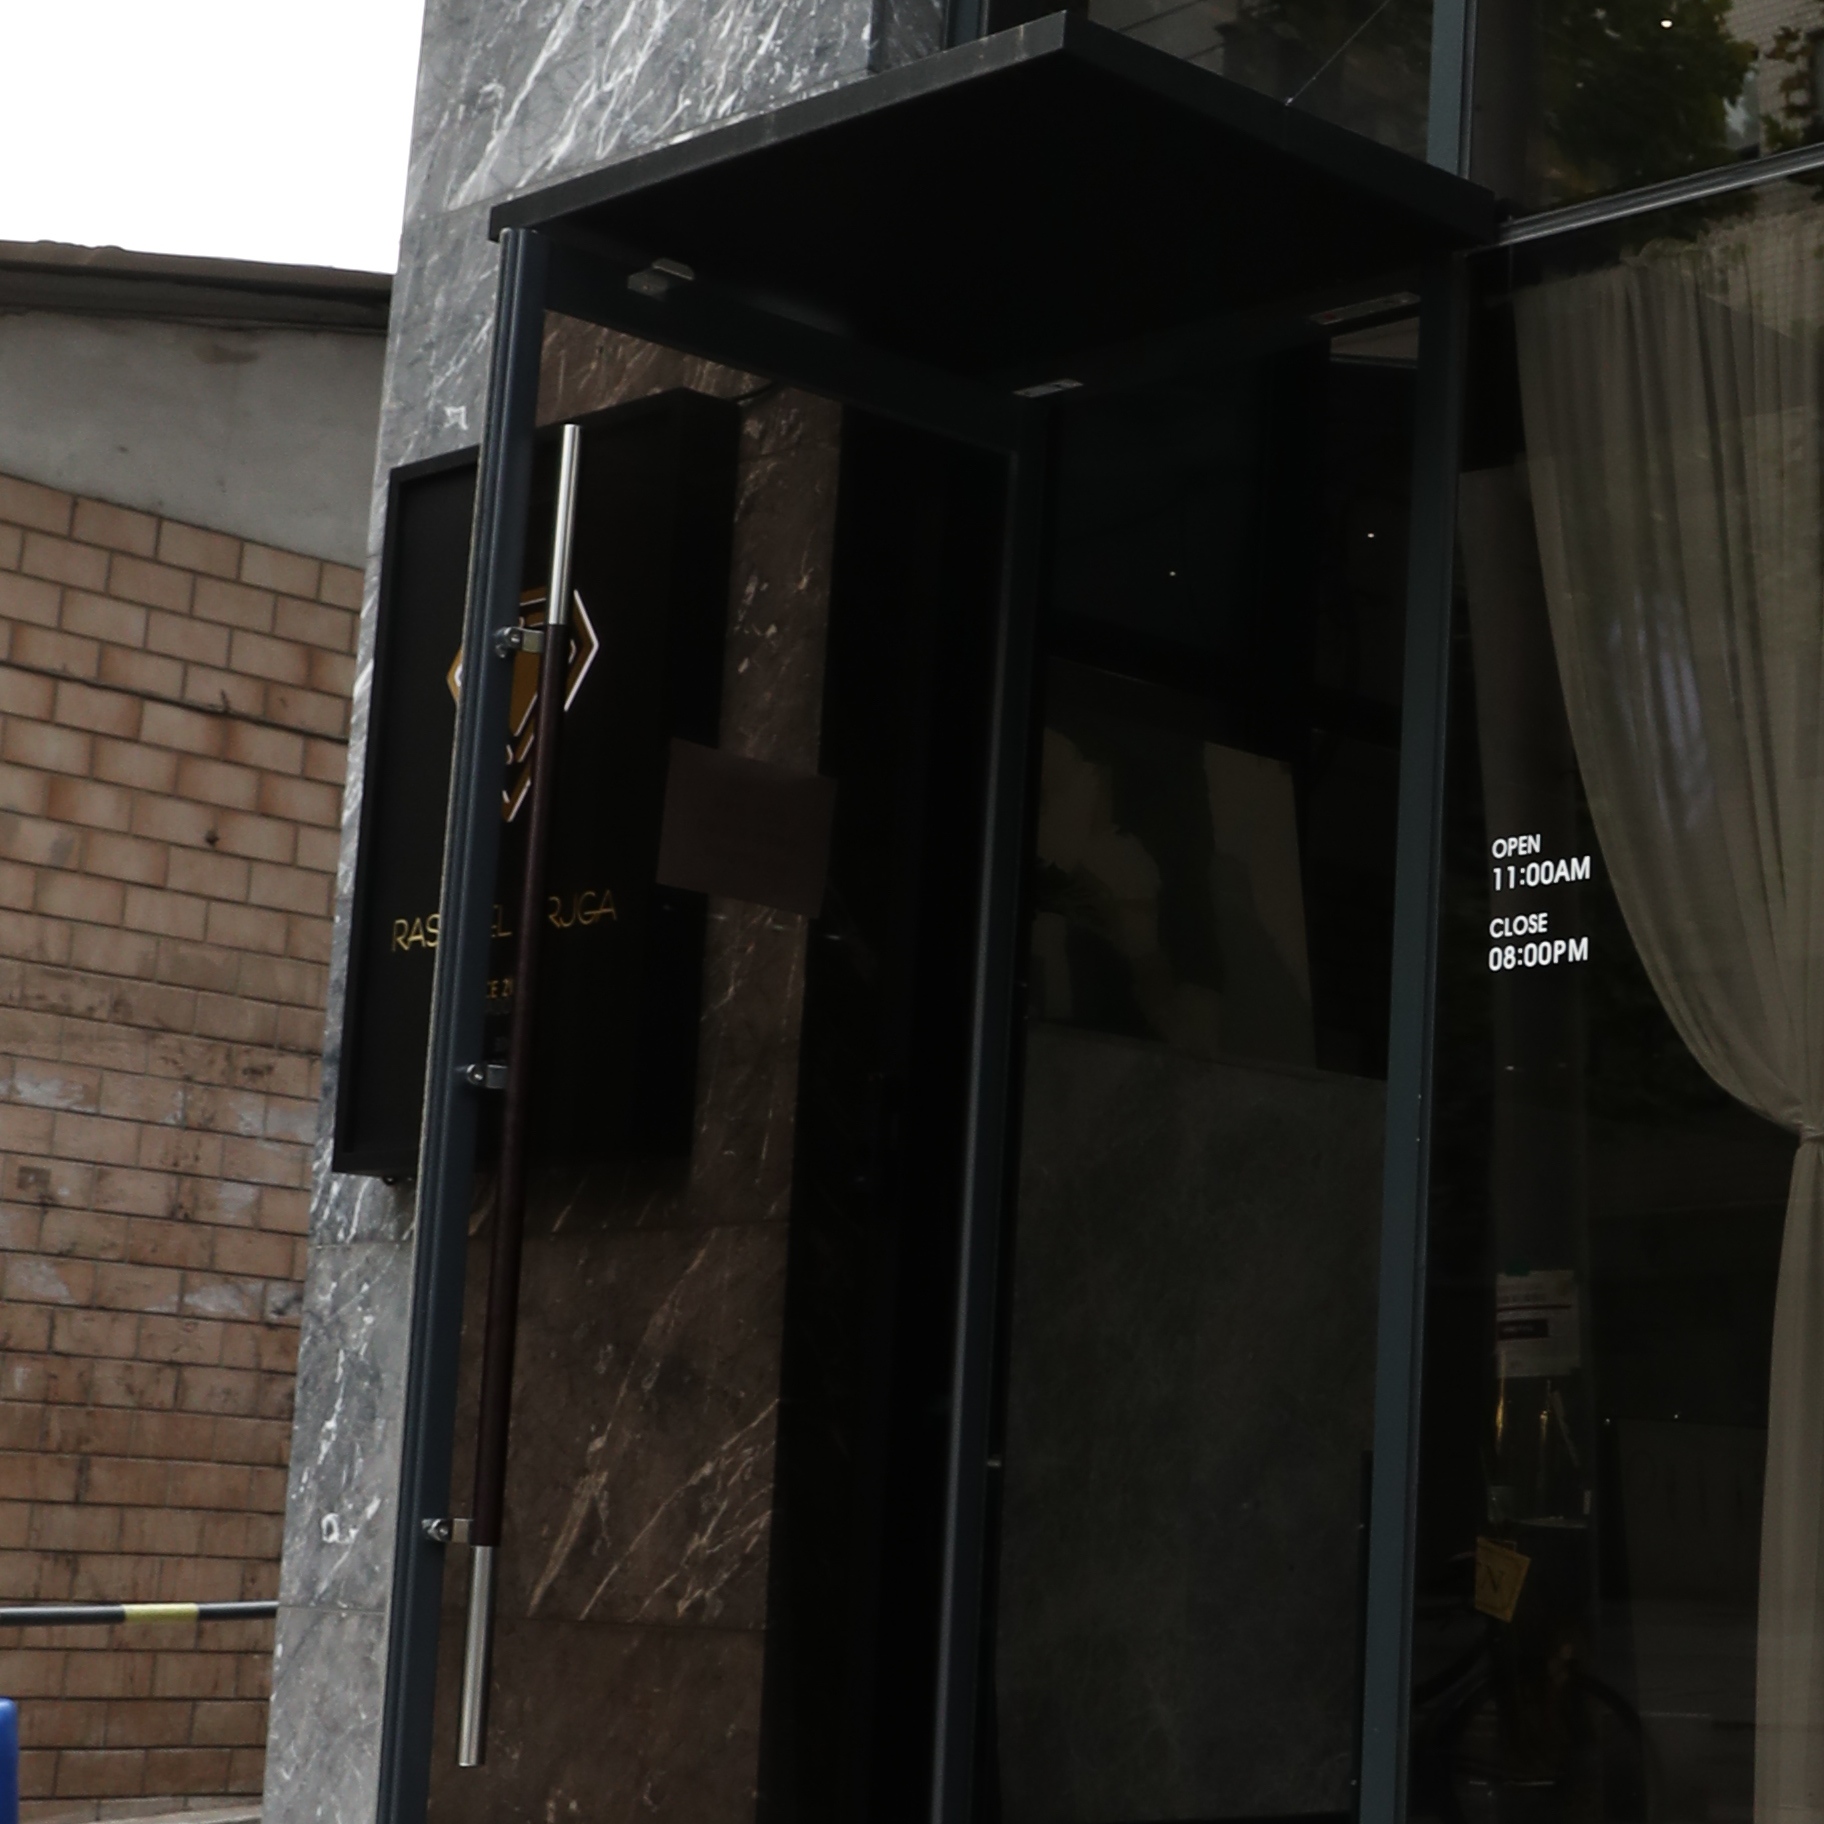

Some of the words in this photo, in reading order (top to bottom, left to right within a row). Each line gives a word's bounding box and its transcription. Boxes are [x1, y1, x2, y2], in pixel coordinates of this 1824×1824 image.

[1491, 833, 1541, 859] OPEN
[1493, 855, 1591, 891] 11:00AM
[1489, 912, 1549, 938] CLOSE
[1488, 936, 1589, 972] 08:00PM
